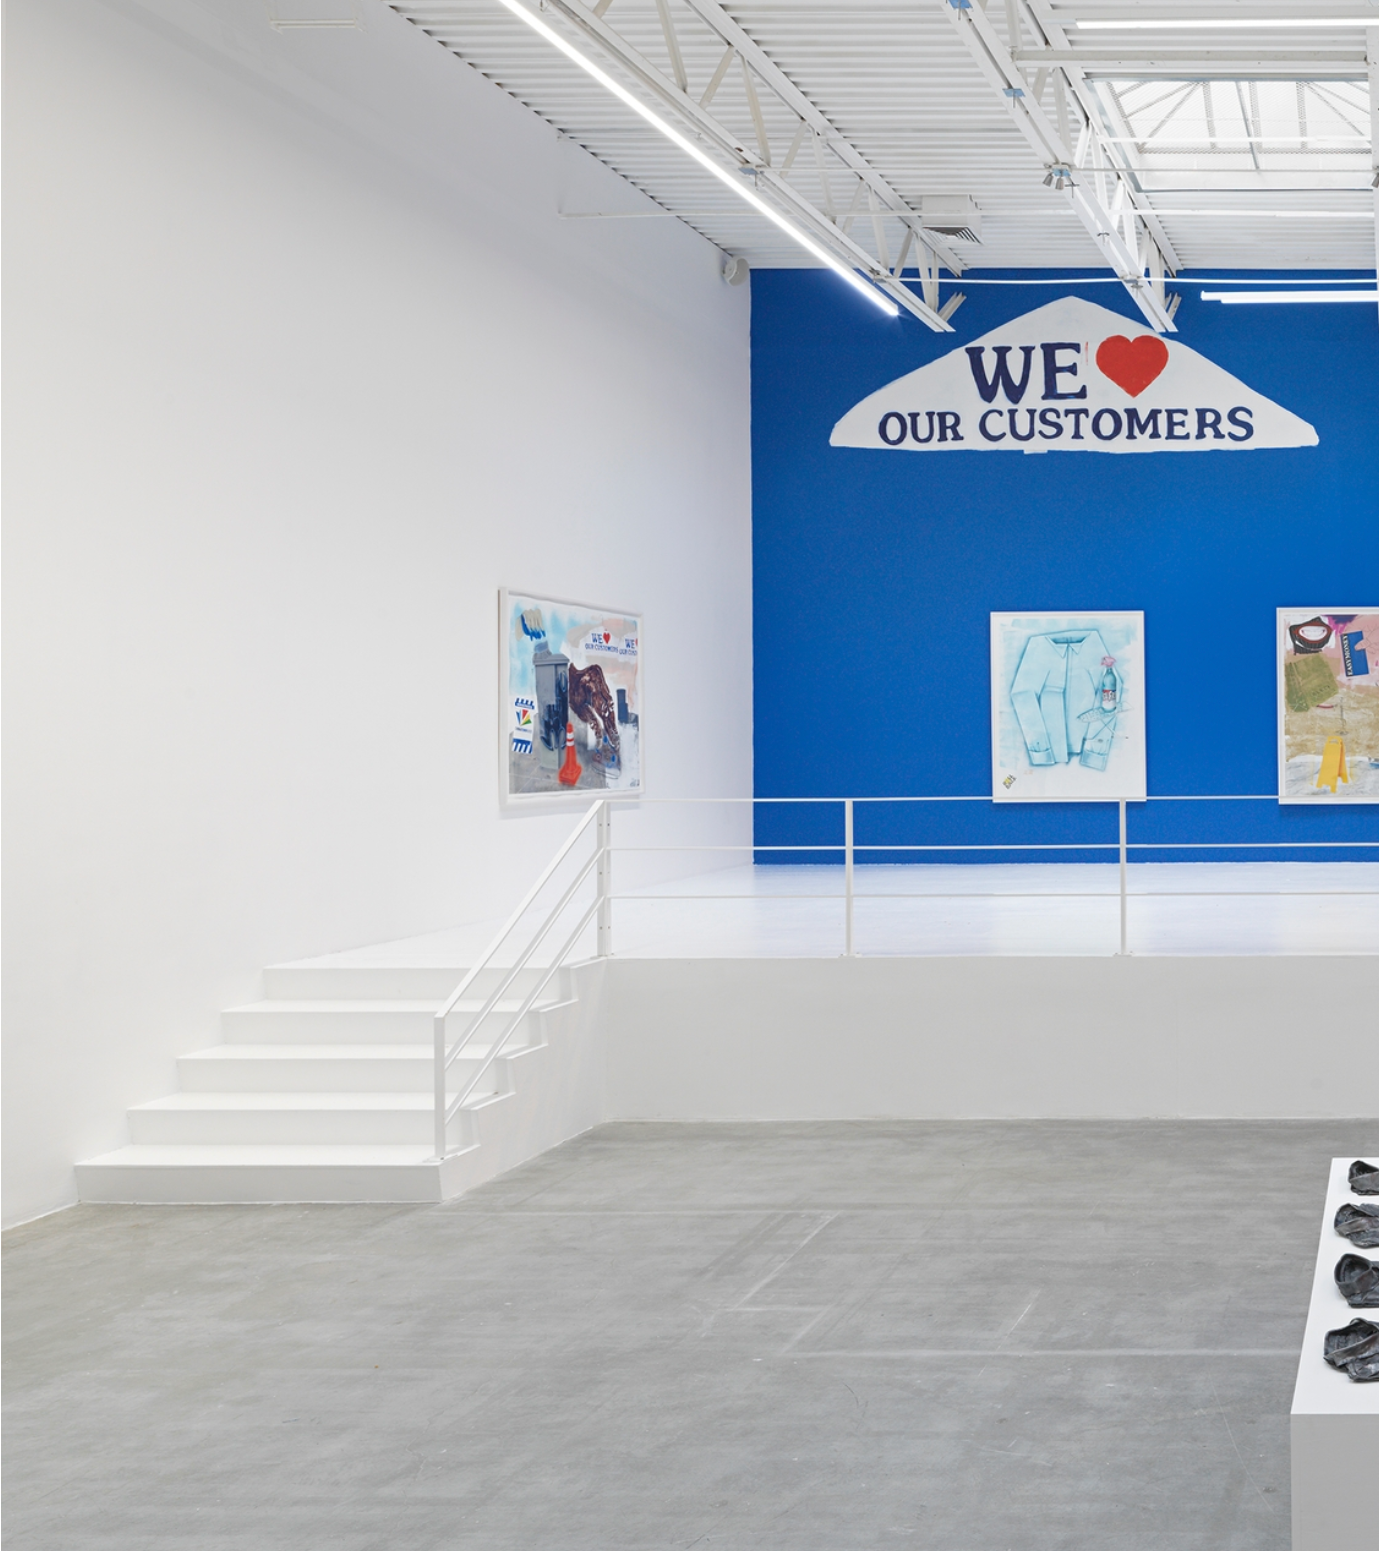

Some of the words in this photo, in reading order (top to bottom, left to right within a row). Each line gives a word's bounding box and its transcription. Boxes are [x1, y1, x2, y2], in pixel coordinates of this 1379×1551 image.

[965, 343, 1087, 404] WE
[879, 412, 963, 445] OUR
[979, 407, 1253, 441] CUSTOMERS
[592, 633, 603, 643] WE
[625, 639, 635, 649] WE
